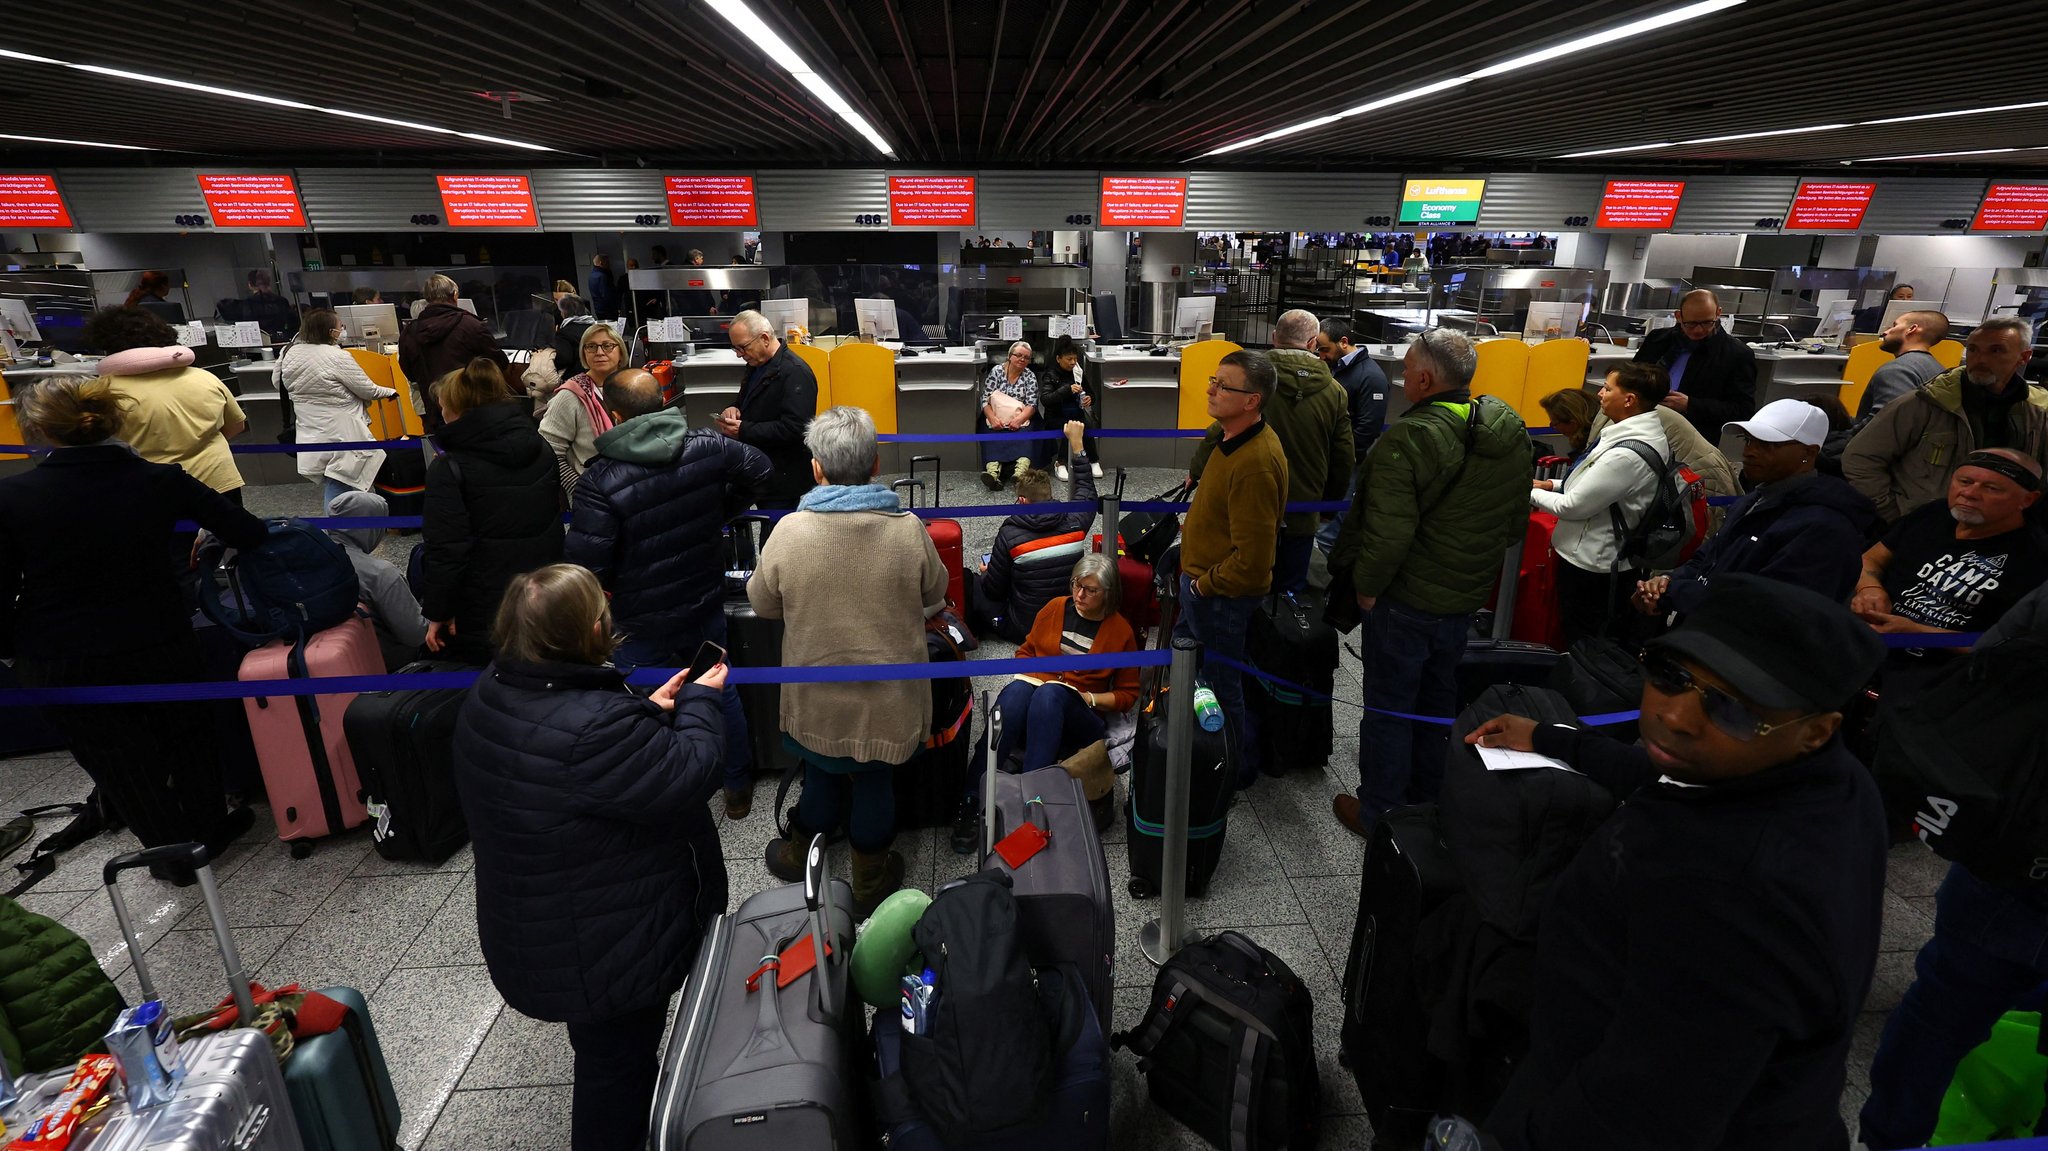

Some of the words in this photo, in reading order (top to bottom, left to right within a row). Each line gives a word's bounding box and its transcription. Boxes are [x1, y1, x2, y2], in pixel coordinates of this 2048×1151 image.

[1425, 186, 1467, 194] Lufthansa
[1422, 204, 1456, 212] Economy
[635, 215, 661, 225] 487
[856, 215, 882, 225] 486
[1066, 215, 1092, 225] 485
[1366, 216, 1390, 226] 483
[1564, 216, 1588, 227] 482
[1935, 554, 1999, 590] CAMP
[1916, 563, 1984, 605] DAVID
